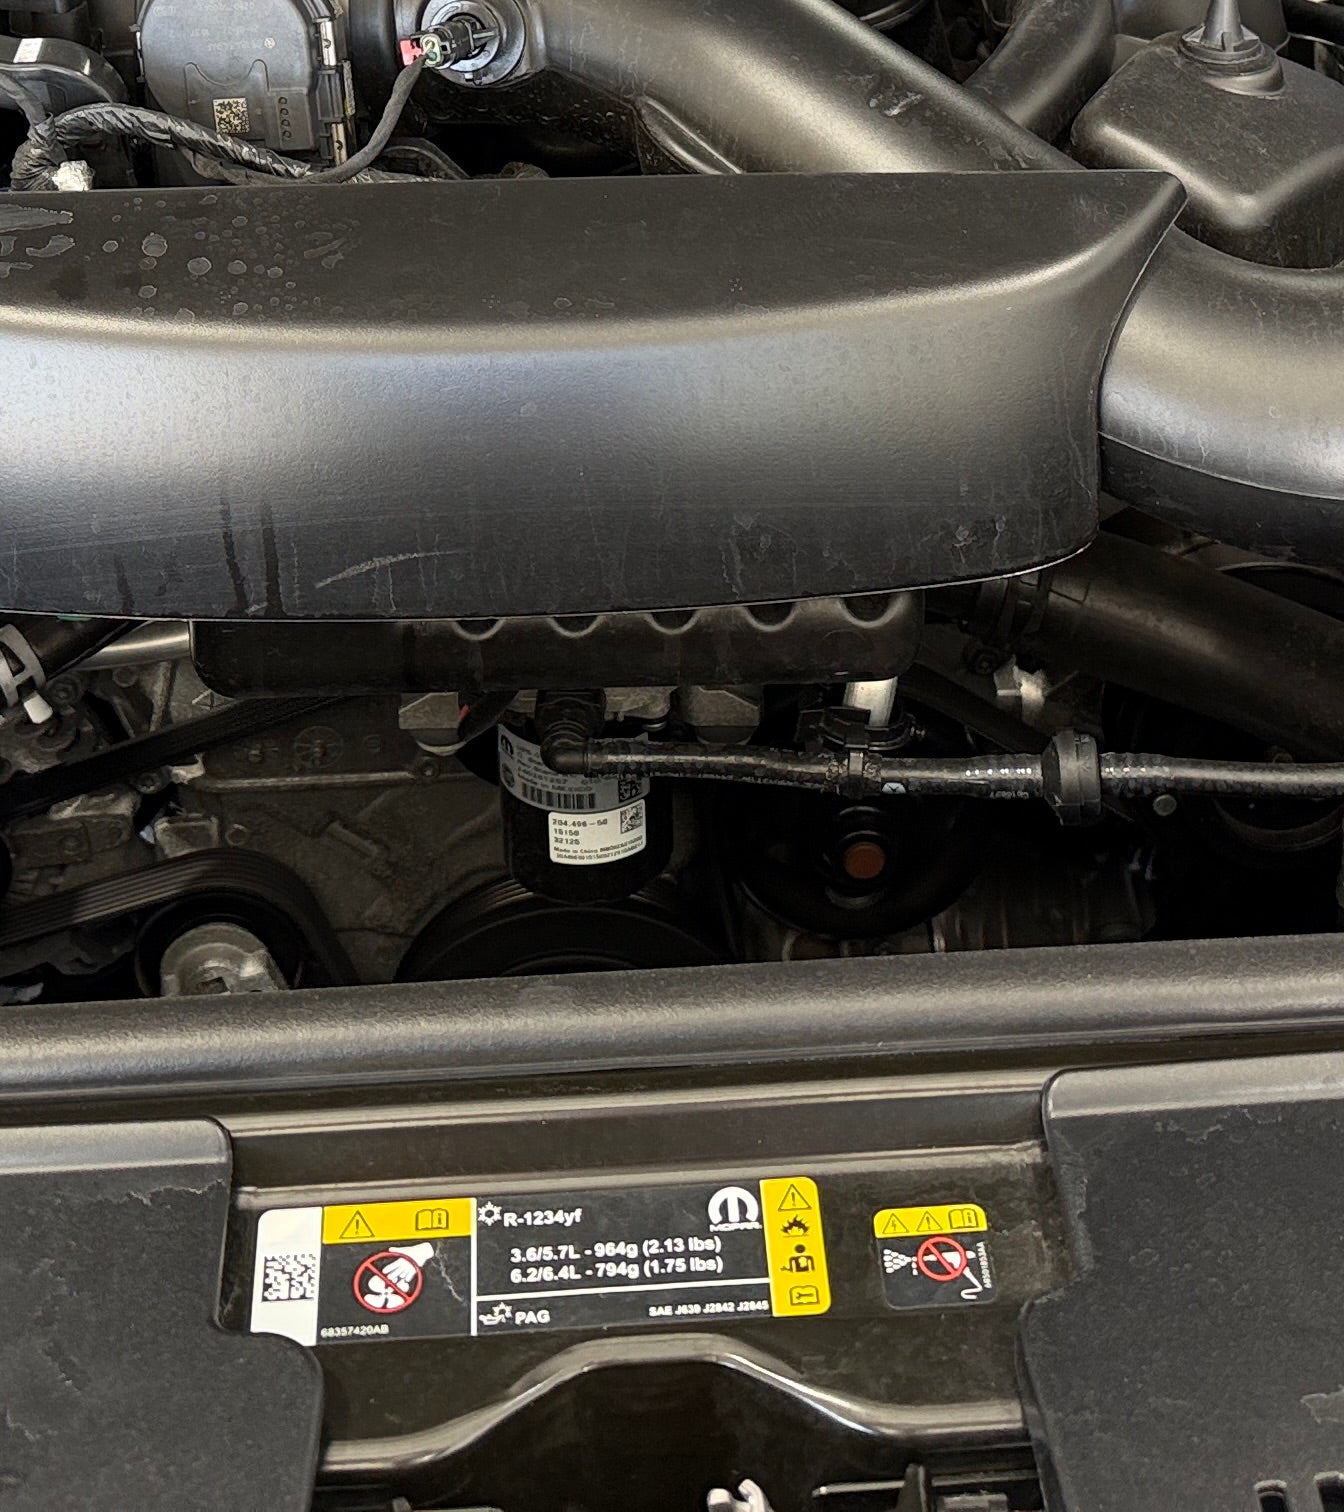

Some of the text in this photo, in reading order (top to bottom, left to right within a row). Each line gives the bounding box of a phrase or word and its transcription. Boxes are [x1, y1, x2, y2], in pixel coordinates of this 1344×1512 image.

[503, 1207, 583, 1227] R-1234yf
[510, 1245, 581, 1263] 3.6/5.7L
[594, 1242, 638, 1260] 964g
[642, 1237, 685, 1257] (2.13
[688, 1235, 722, 1253] lbs)
[510, 1265, 582, 1283] 6.2/6.4L
[595, 1262, 640, 1280] 794g
[643, 1257, 687, 1278] (1.75
[689, 1255, 724, 1273] lbs)
[515, 1309, 551, 1325] PAG
[648, 1305, 673, 1317] SAE
